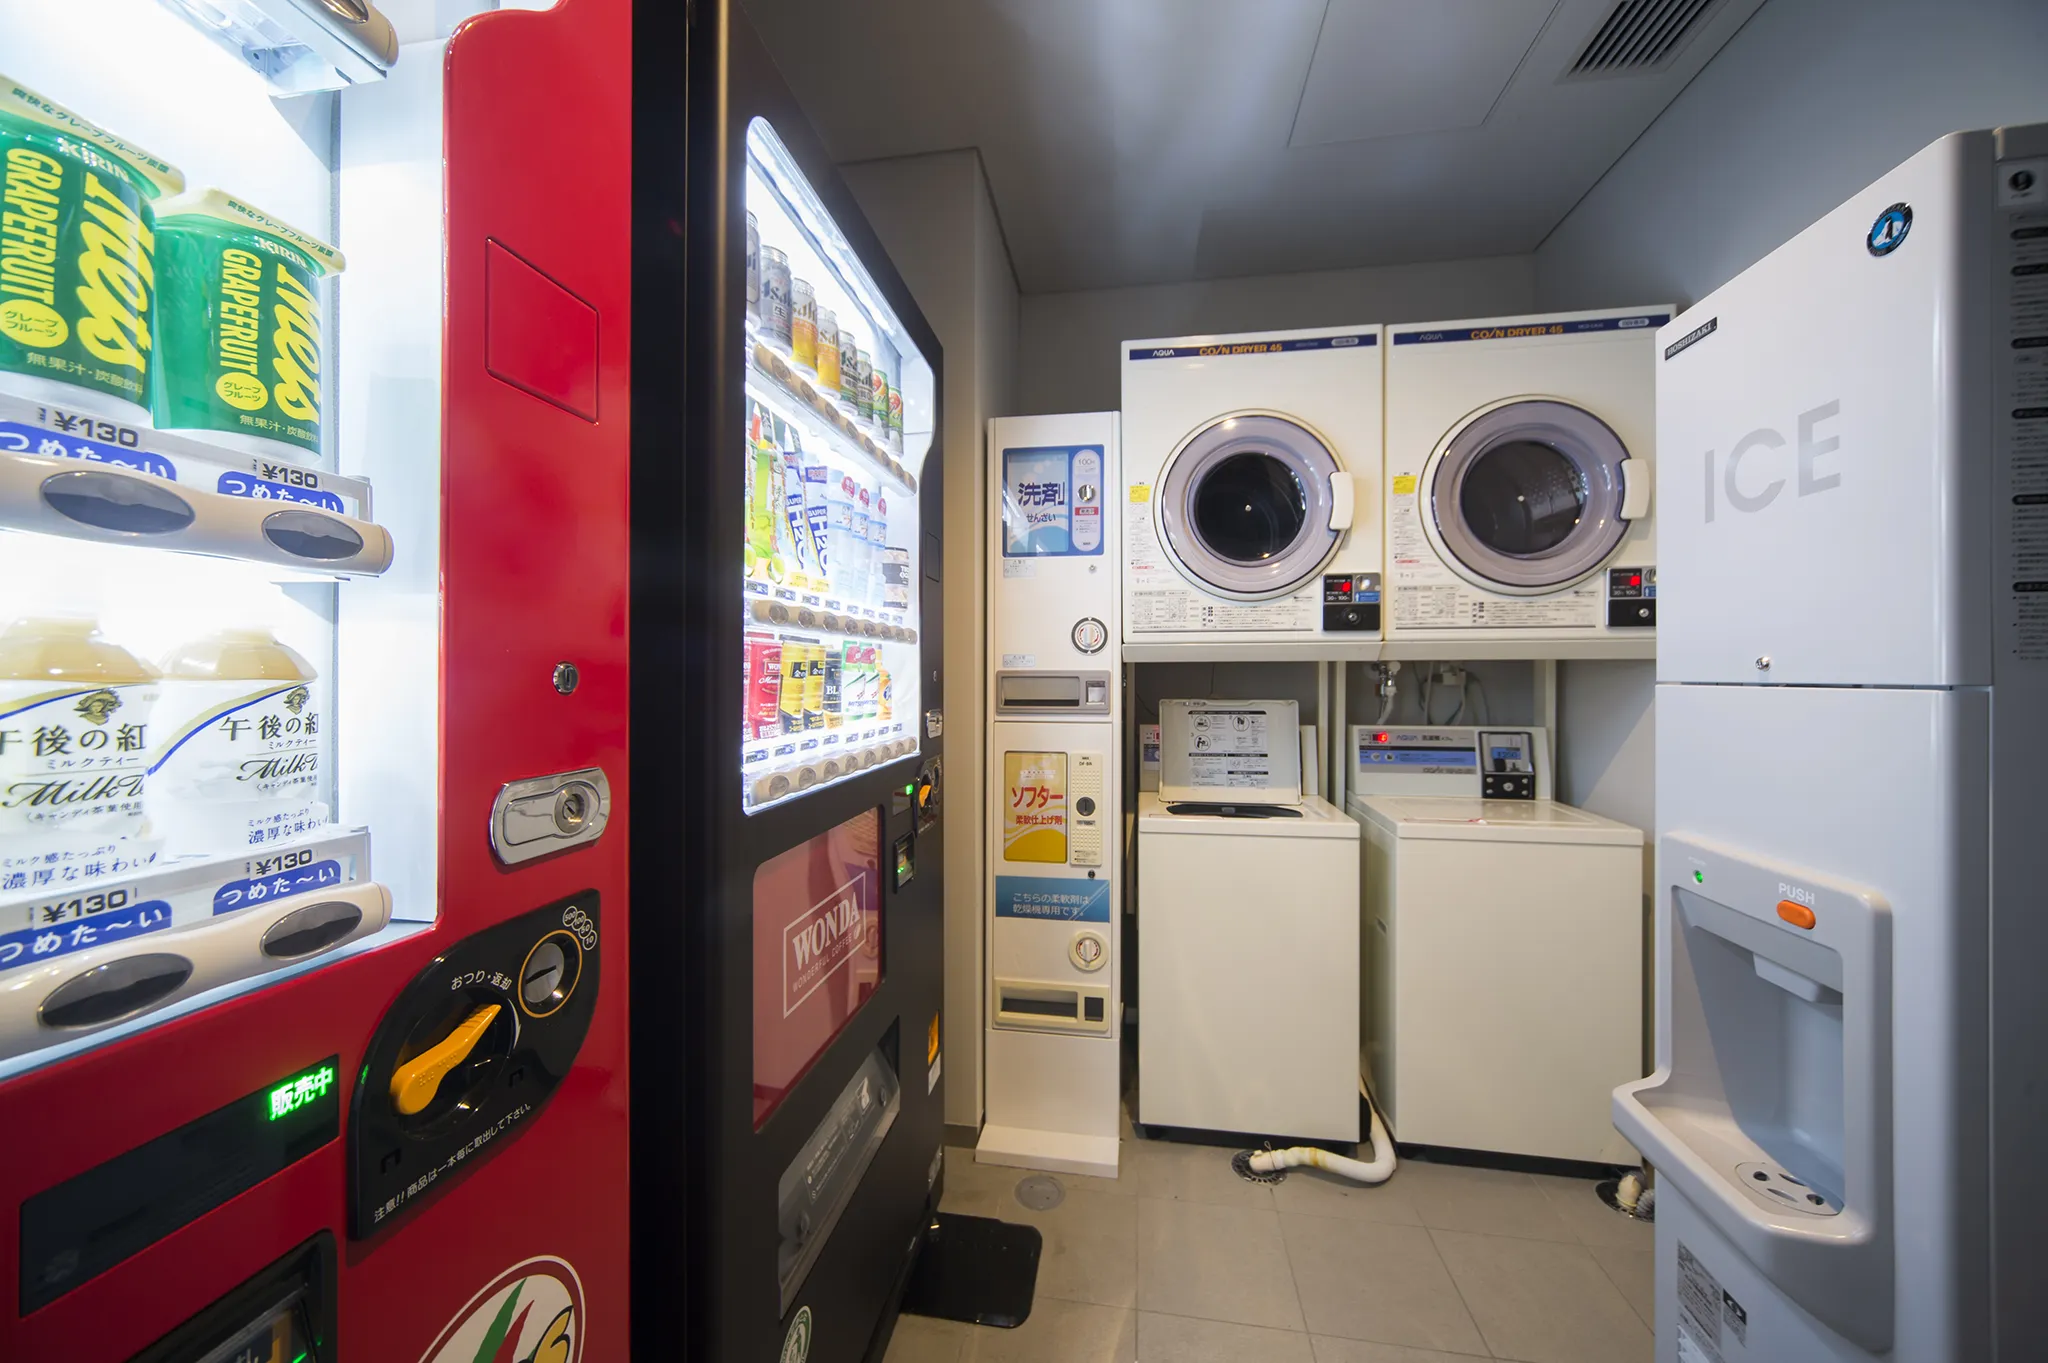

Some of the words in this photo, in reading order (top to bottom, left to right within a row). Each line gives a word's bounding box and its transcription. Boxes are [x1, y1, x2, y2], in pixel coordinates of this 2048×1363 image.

[57, 137, 131, 184] KIRIN
[1, 148, 63, 305] GRAPEFRUIT
[254, 235, 308, 269] KIRIN
[4, 310, 59, 328] グレープ
[220, 248, 262, 375] GRAPEFRUIT
[7, 321, 58, 338] フルーツ
[1418, 332, 1443, 341] AQUA
[1507, 326, 1546, 338] DRYER
[1549, 325, 1563, 335] 45
[1666, 322, 1712, 358] HOSHIZAKI
[1152, 349, 1175, 357] AQUA
[1232, 344, 1267, 355] DRYER
[223, 381, 262, 394] グレープ
[224, 390, 261, 402] フルーツ
[54, 410, 139, 448] ¥130
[1704, 398, 1842, 524] ICE
[262, 463, 318, 488] ¥130
[1017, 481, 1065, 506] 洗剤
[1026, 512, 1056, 523] せんざい
[268, 739, 317, 750] ミルクティー
[47, 757, 139, 769] ミルクティー
[236, 753, 306, 781] Milk
[1, 775, 118, 808] Milk
[1011, 784, 1064, 809] ソフター
[248, 808, 310, 827] ミルク感たっぷり
[1015, 814, 1063, 825] 柔軟仕上げ剤
[3, 844, 116, 867] ミルク感たっぷり
[255, 849, 314, 876] ¥130
[1012, 892, 1091, 905] こちらの柔軟剤は
[1778, 882, 1816, 905] PUSH
[42, 889, 129, 924] ¥130
[1012, 903, 1084, 917] 乾燥機専用です。
[792, 891, 861, 971] WONDA
[792, 954, 830, 993] WONDERFUL
[831, 932, 853, 958] COFFEE
[268, 1066, 334, 1121] 販売中
